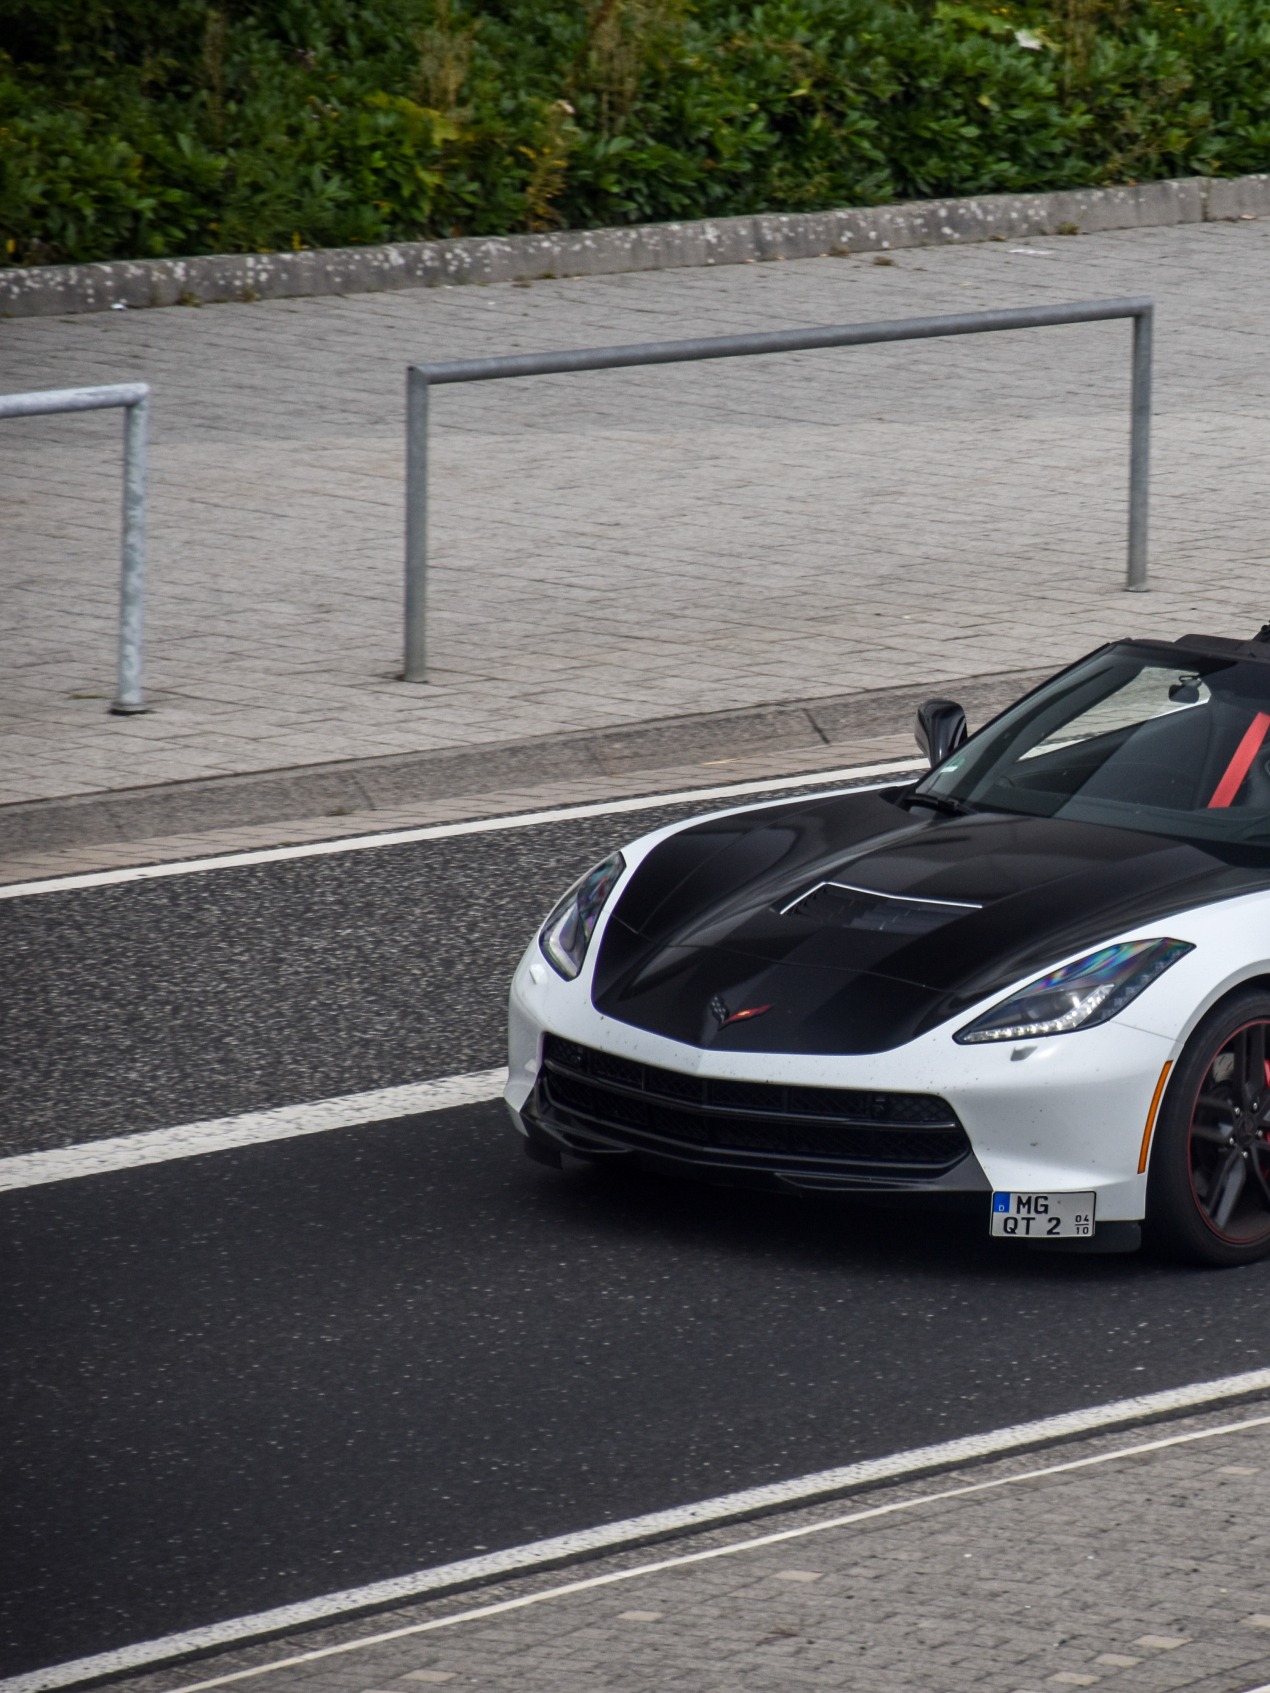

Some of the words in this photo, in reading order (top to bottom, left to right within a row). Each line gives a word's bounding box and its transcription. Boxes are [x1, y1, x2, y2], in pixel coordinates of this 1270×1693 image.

[998, 1204, 1005, 1212] D
[1016, 1195, 1049, 1214] MG
[1075, 1214, 1089, 1223] 04
[1003, 1216, 1036, 1235] QT
[1046, 1216, 1061, 1235] 2
[1076, 1226, 1089, 1235] 10
